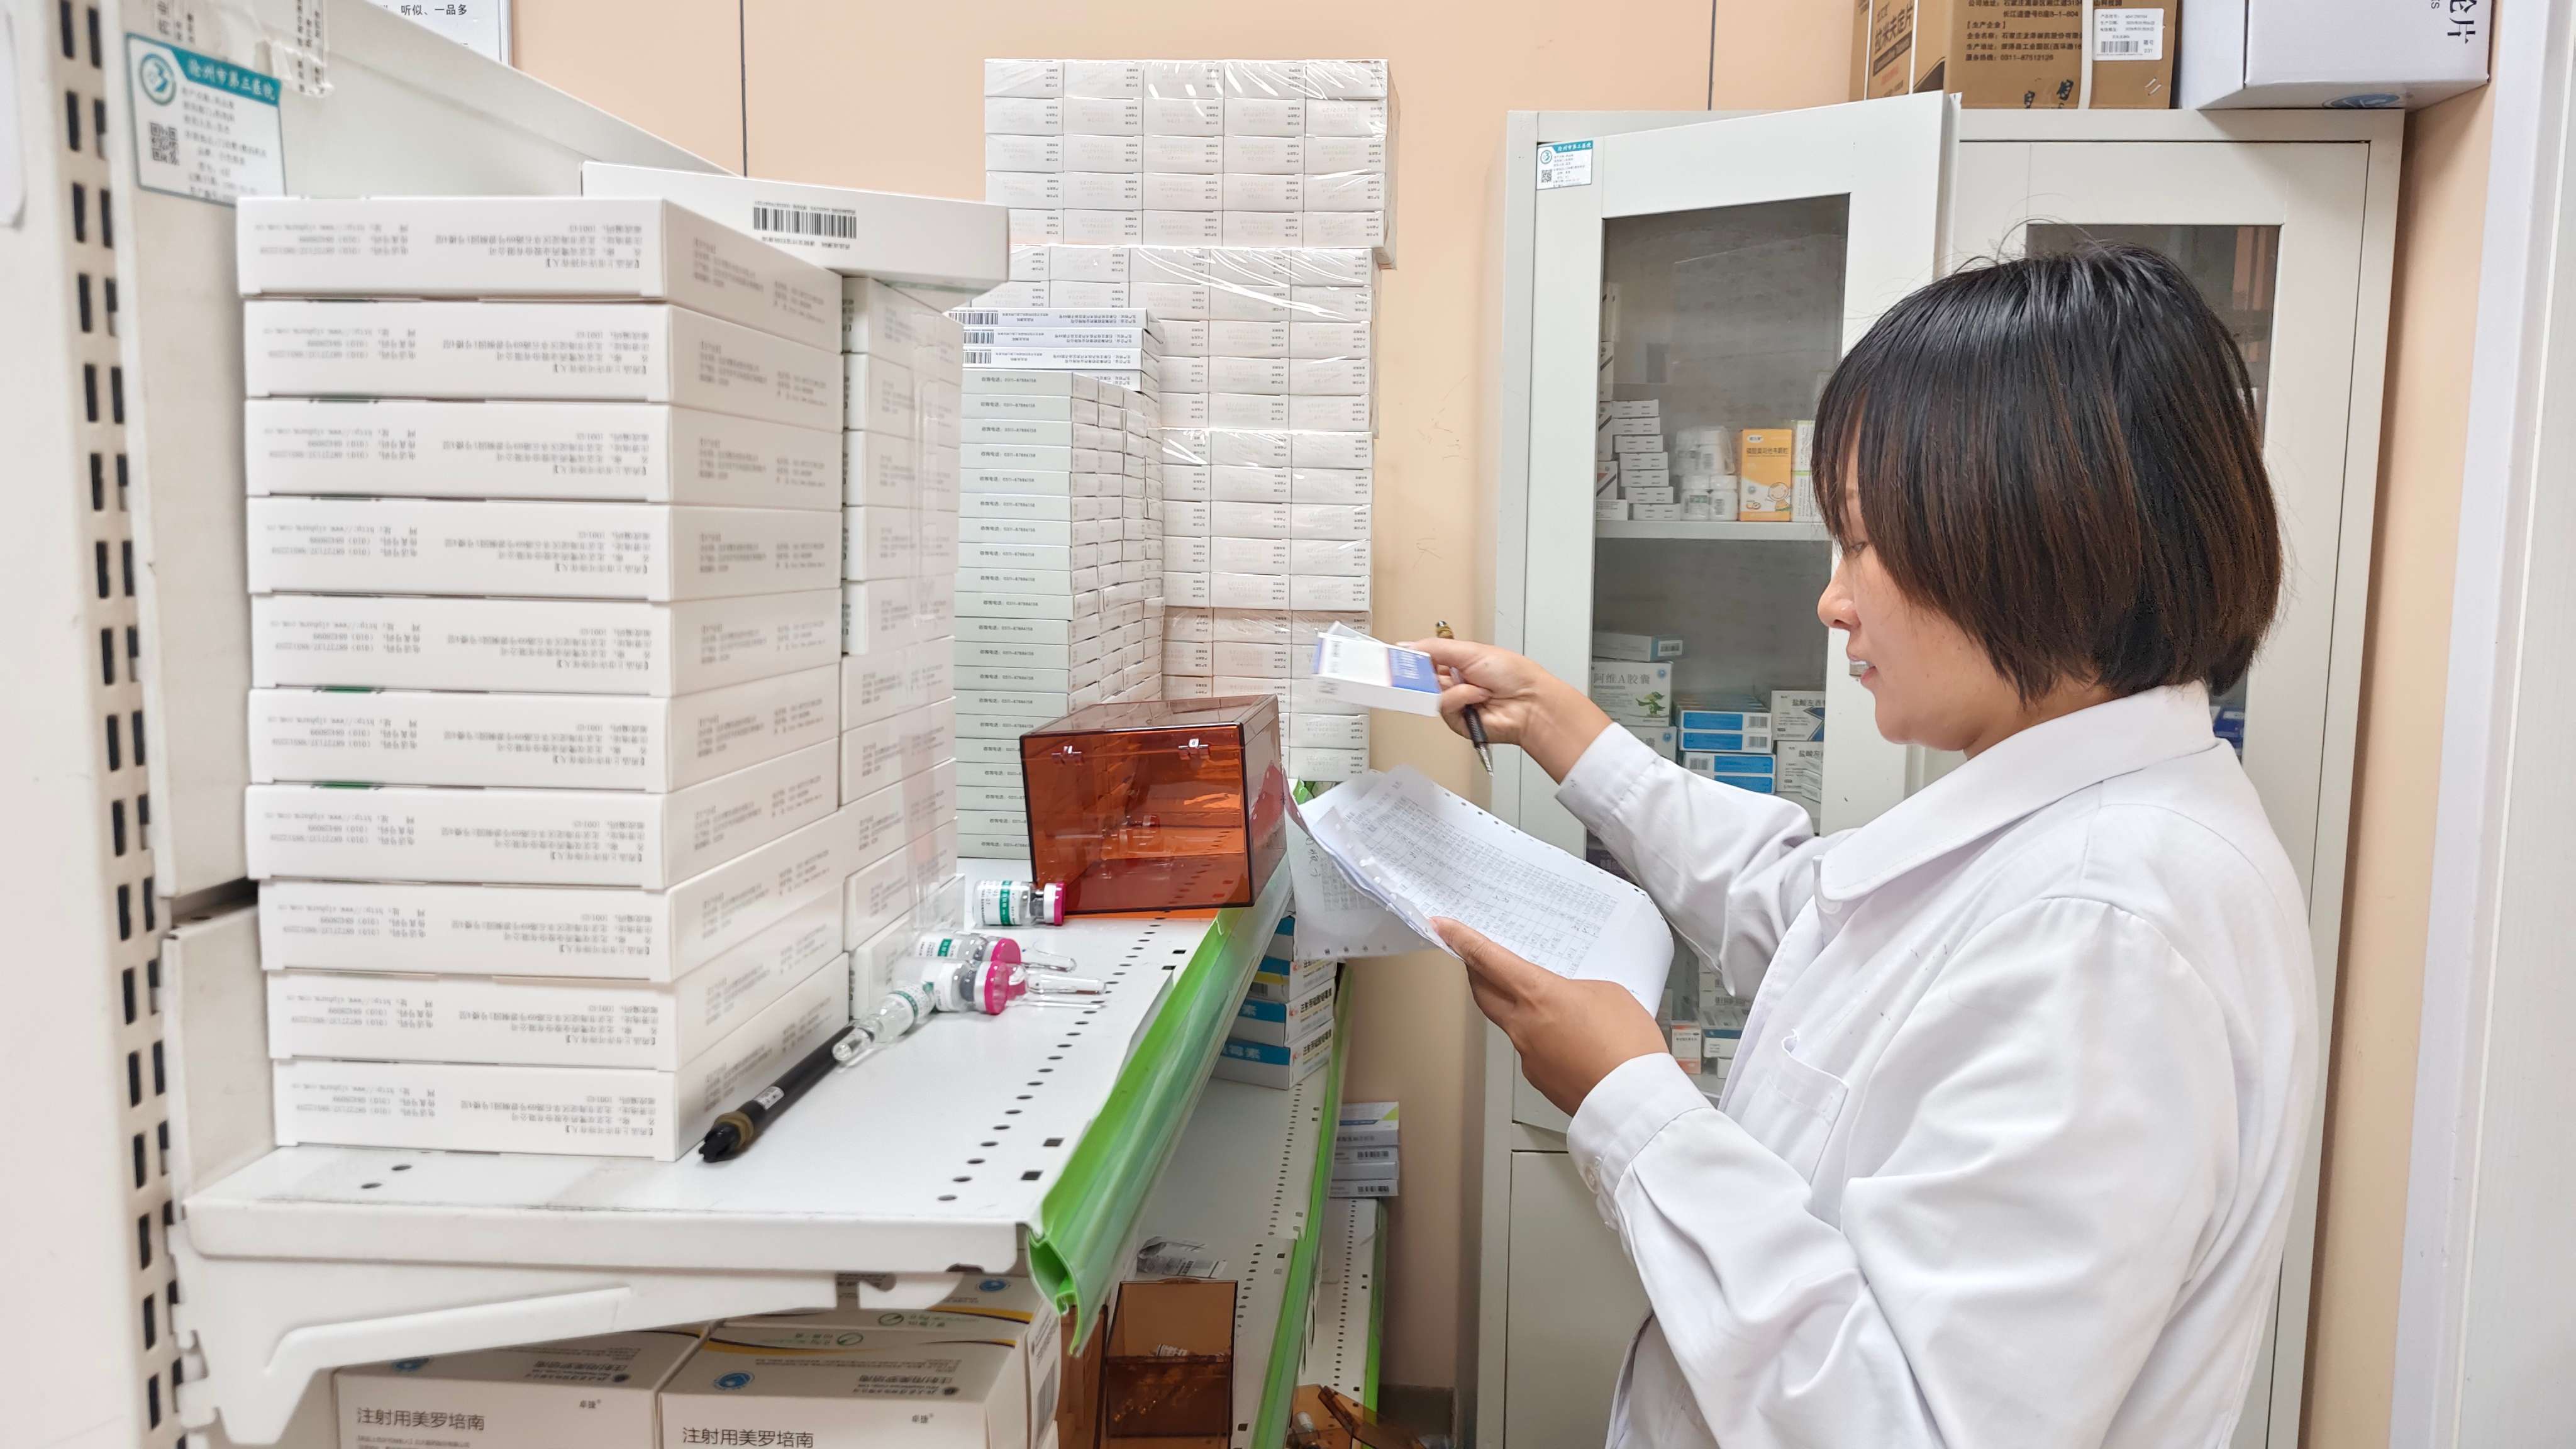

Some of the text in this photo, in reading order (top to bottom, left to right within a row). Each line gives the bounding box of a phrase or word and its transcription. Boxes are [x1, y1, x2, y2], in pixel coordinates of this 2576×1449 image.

[187, 58, 275, 102] 沧州市第三医院
[1594, 672, 1650, 685] 阿维A胶囊
[357, 1406, 485, 1431] 注射用美罗培南
[682, 1426, 814, 1448] 注射用美罗培南
